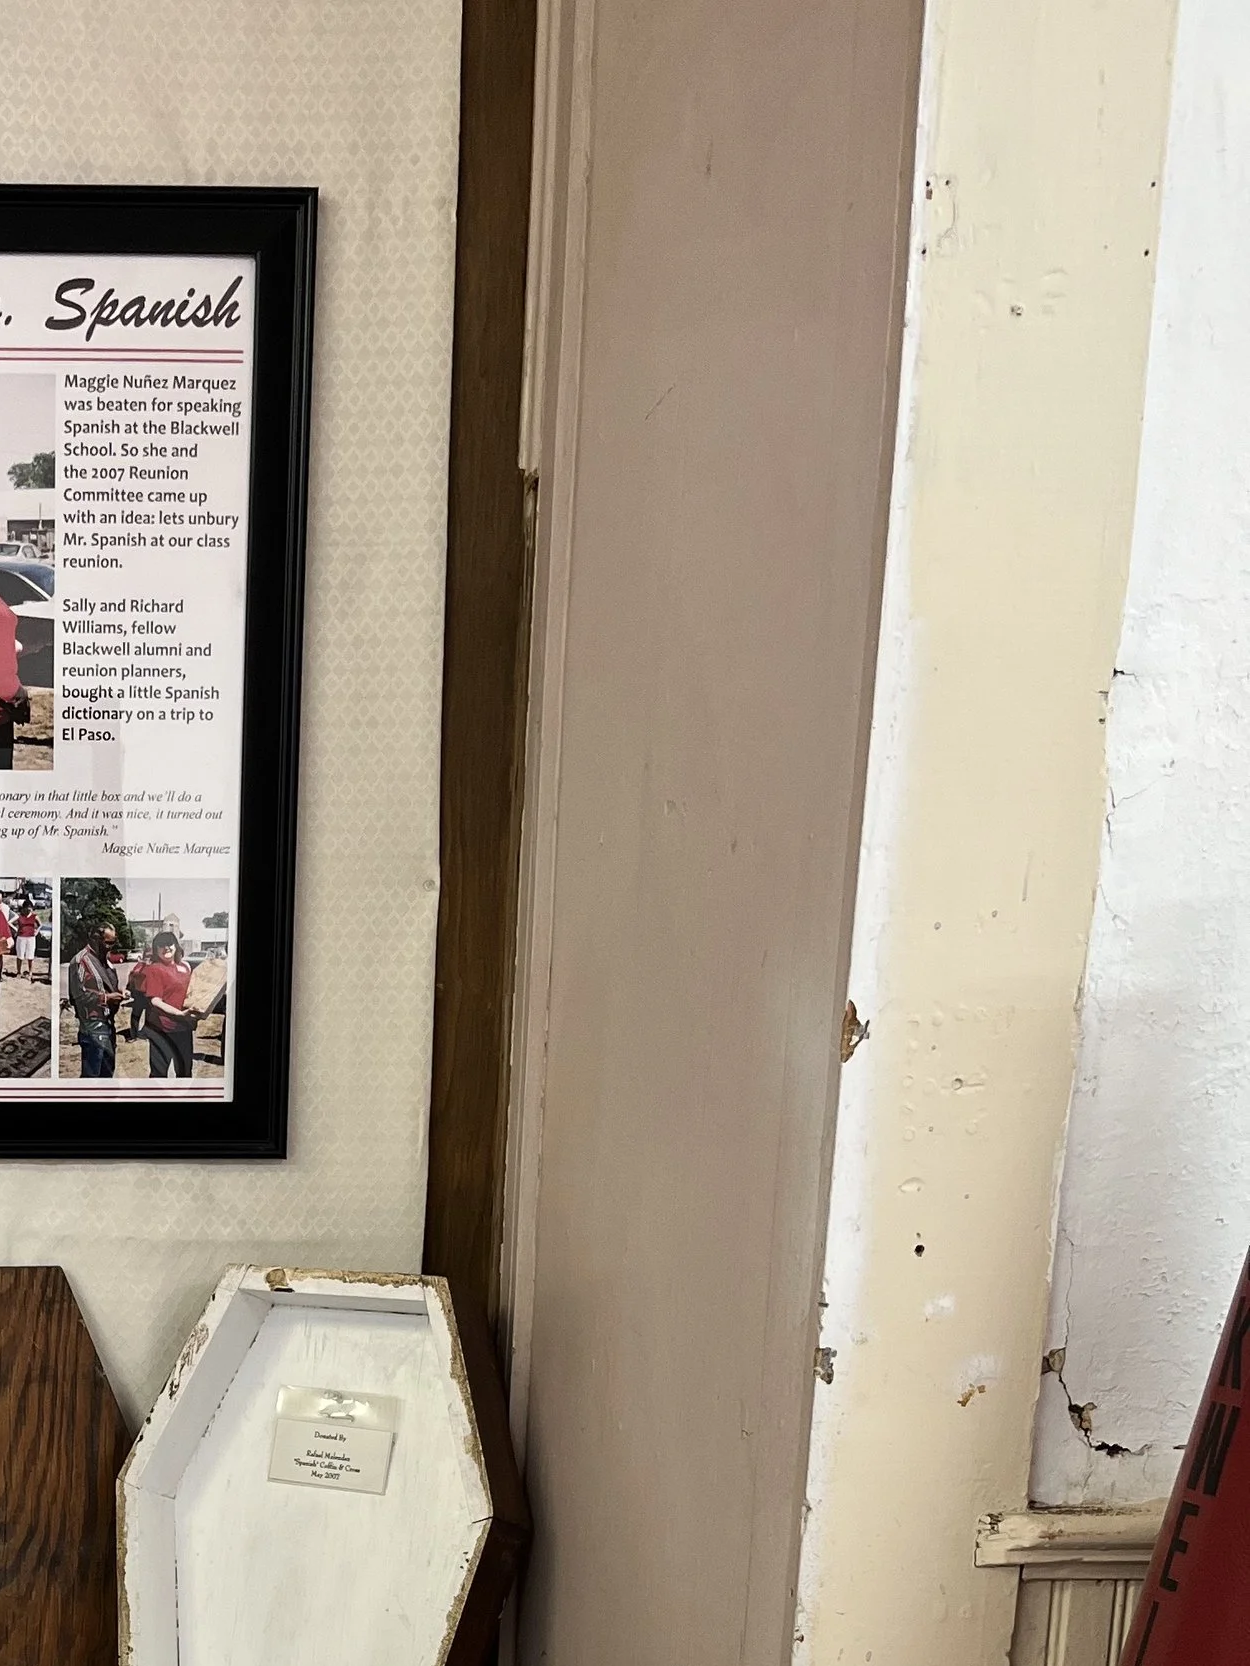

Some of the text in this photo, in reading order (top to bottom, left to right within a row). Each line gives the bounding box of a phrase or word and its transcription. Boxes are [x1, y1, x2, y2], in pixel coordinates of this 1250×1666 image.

[44, 275, 244, 342] Spanish
[64, 373, 236, 394] Maggie Nuñez Marquez
[63, 396, 242, 418] was beaten for speaking
[63, 419, 239, 438] Spanish at the Blackwell
[63, 441, 198, 458] School. So she and
[63, 464, 188, 482] the 2007 Reunion
[63, 487, 207, 507] Committee came up
[62, 509, 239, 530] with an idea: lets unbury
[63, 532, 230, 550] Mr. Spanish at our class
[62, 554, 123, 569] reunion.
[62, 597, 184, 616] Sally and Richard
[62, 619, 176, 637] Williams, fellow
[62, 641, 211, 656] Blackwell alumni and
[62, 663, 186, 681] reunion planners,
[62, 684, 219, 703] bought a little Spanish
[61, 705, 213, 724] dictionary on a trip to
[62, 726, 115, 741] El Paso.
[101, 842, 231, 857] Maggie Nuñez Marquez
